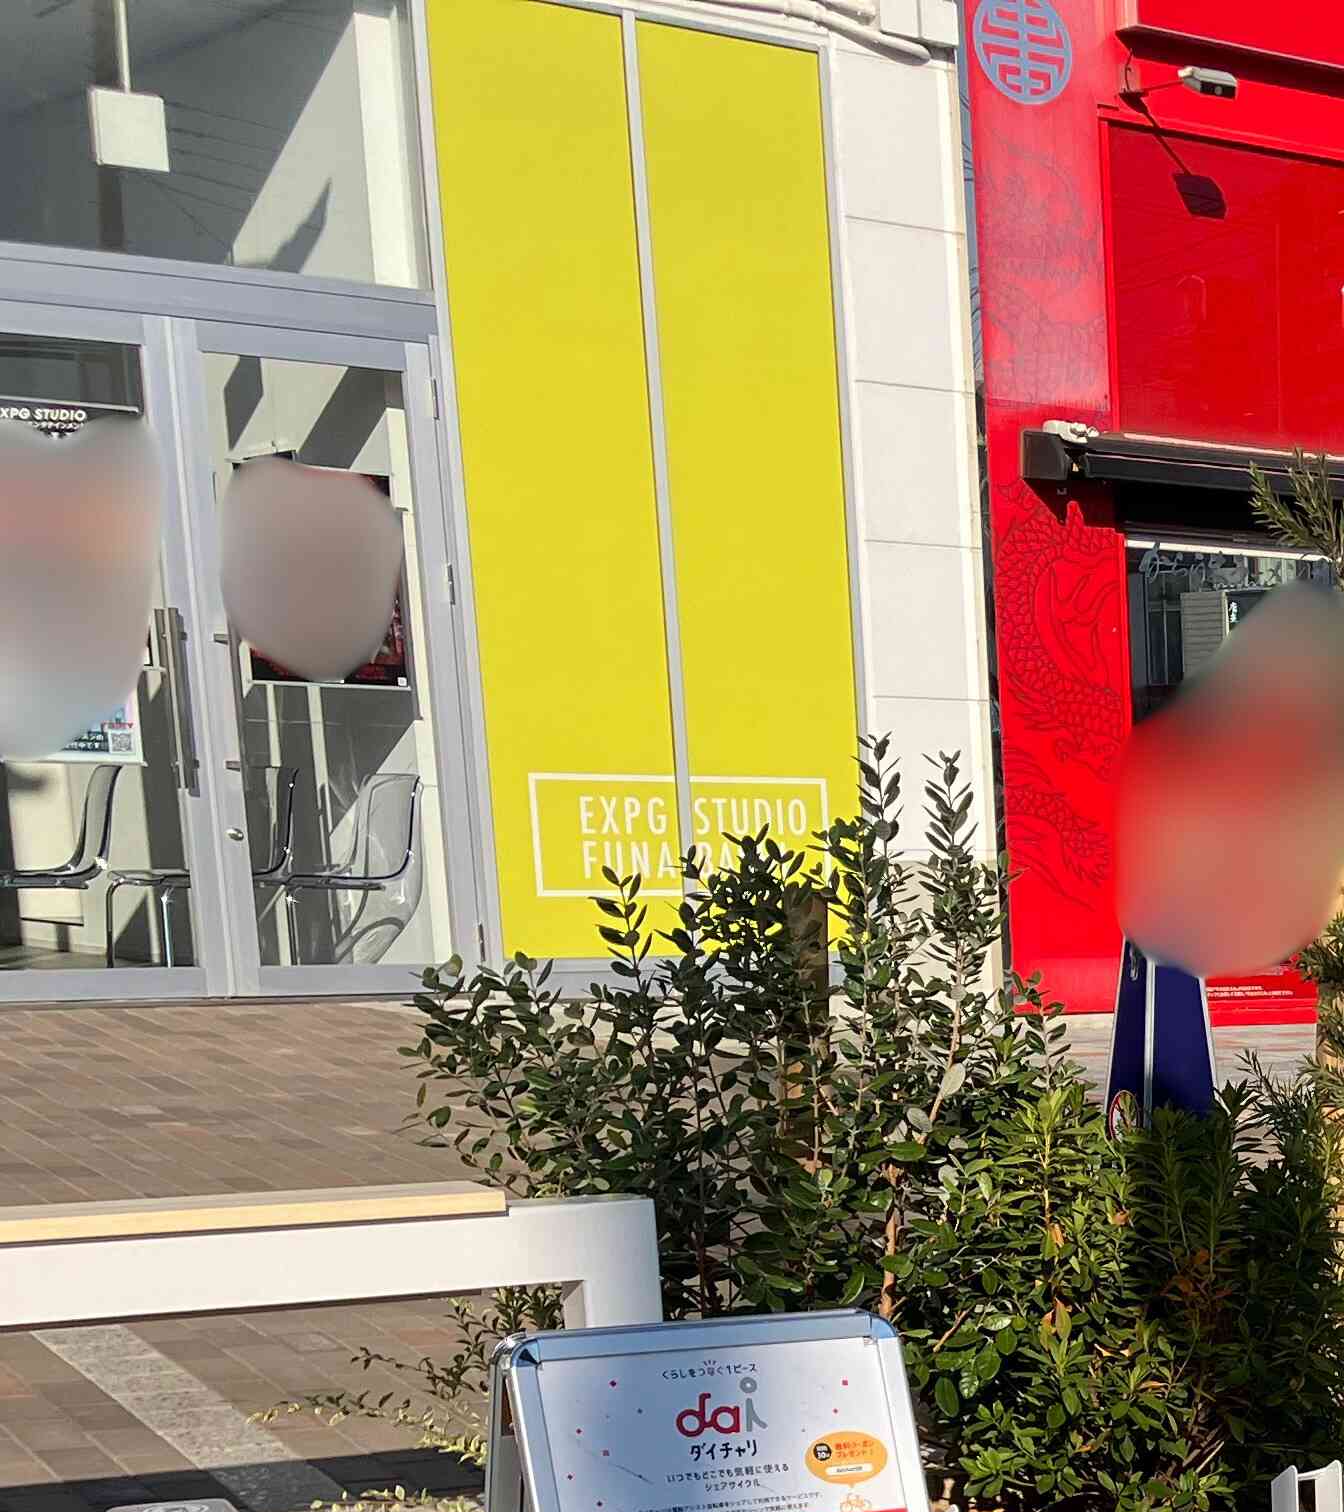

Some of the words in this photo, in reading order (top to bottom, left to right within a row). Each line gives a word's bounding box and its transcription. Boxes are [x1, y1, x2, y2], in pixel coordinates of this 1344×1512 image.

[34, 408, 87, 421] STUDIO
[579, 796, 668, 834] EXPG
[694, 797, 807, 835] STUDIO
[690, 1439, 758, 1462] ダイチャリ
[667, 1463, 790, 1483] いつでもどこでも気軽に使える
[705, 1480, 761, 1492] シェアサイクル
